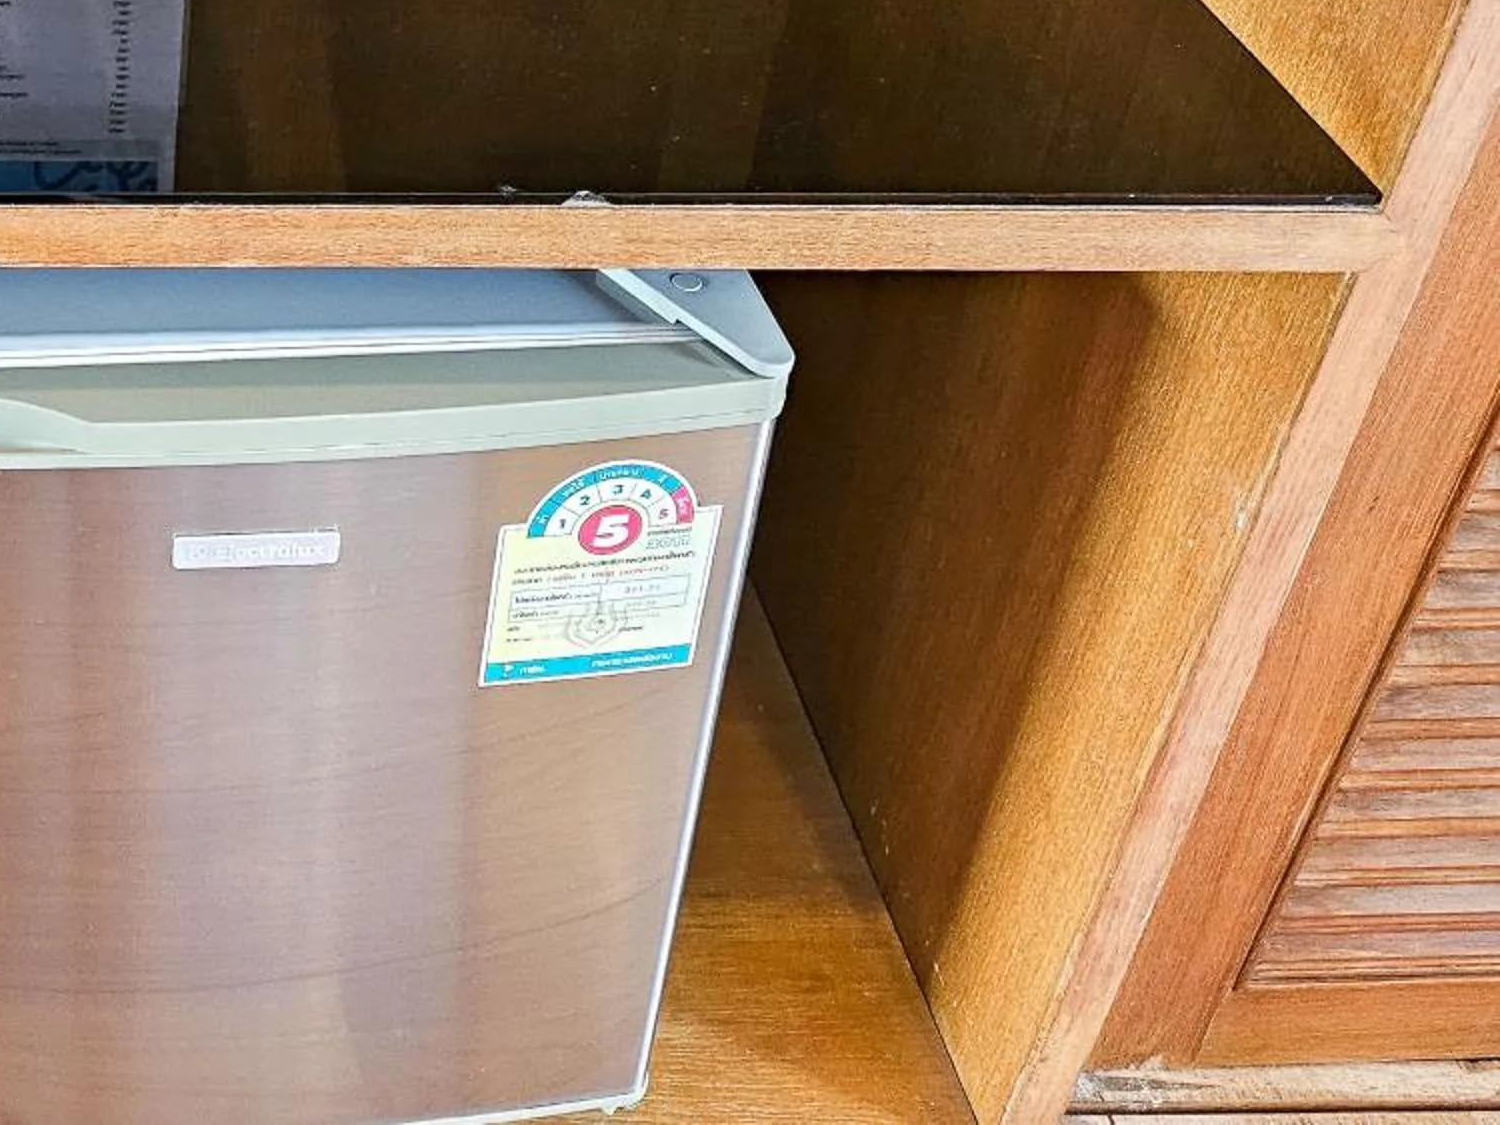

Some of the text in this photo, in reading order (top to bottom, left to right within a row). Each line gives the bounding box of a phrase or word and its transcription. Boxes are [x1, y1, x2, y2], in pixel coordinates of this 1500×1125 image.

[559, 484, 669, 528] 1 2 3 4 5
[593, 514, 631, 548] 5
